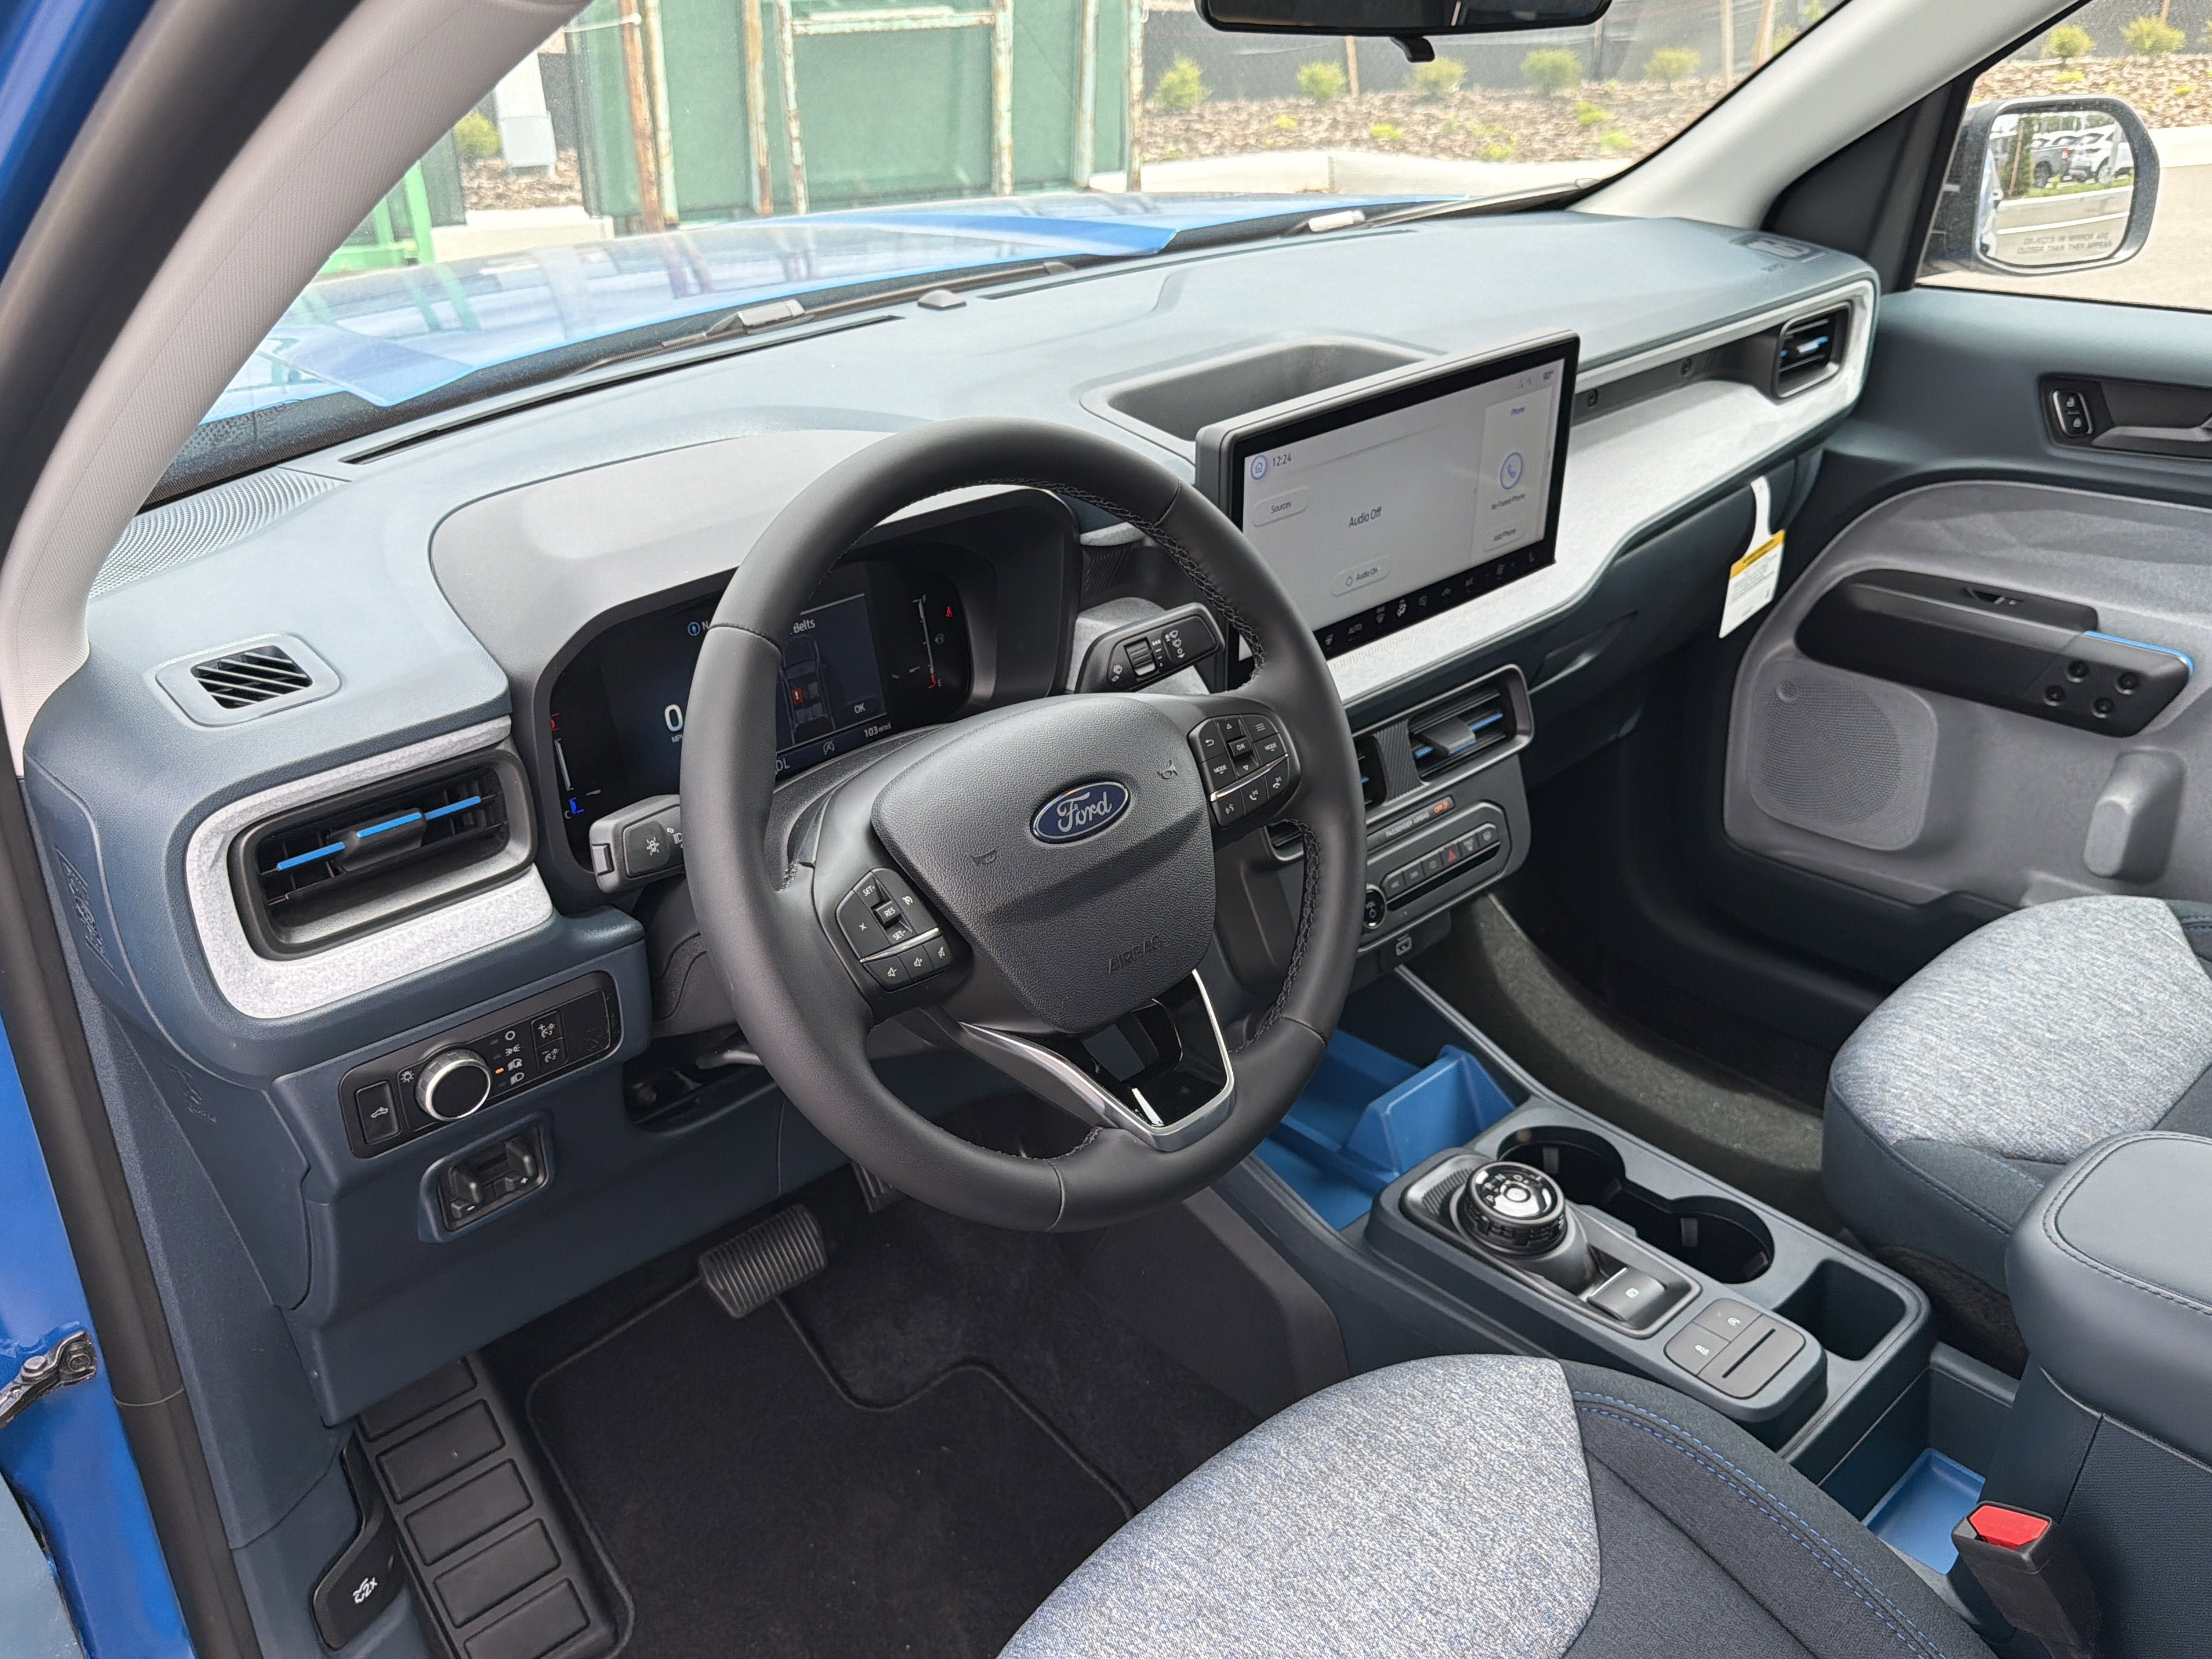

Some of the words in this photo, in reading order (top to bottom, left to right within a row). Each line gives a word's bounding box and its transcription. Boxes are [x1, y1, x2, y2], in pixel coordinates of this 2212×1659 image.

[1272, 453, 1292, 468] 12:24
[1270, 501, 1292, 514] Sources
[1348, 511, 1370, 528] Audio
[1370, 506, 1382, 520] Off
[1356, 569, 1370, 581] Audio
[923, 594, 927, 603] F
[793, 619, 816, 634] Belts
[938, 679, 943, 687] E
[854, 702, 866, 714] OK
[664, 704, 684, 732] 0
[864, 726, 879, 738] 103
[1236, 742, 1245, 751] OK
[1264, 742, 1278, 751] MODE
[1213, 764, 1228, 774] MODE
[564, 810, 572, 820] C
[1057, 791, 1113, 833] Ford
[862, 884, 876, 897] SET+
[883, 906, 896, 918] RES
[892, 929, 906, 941] SET-
